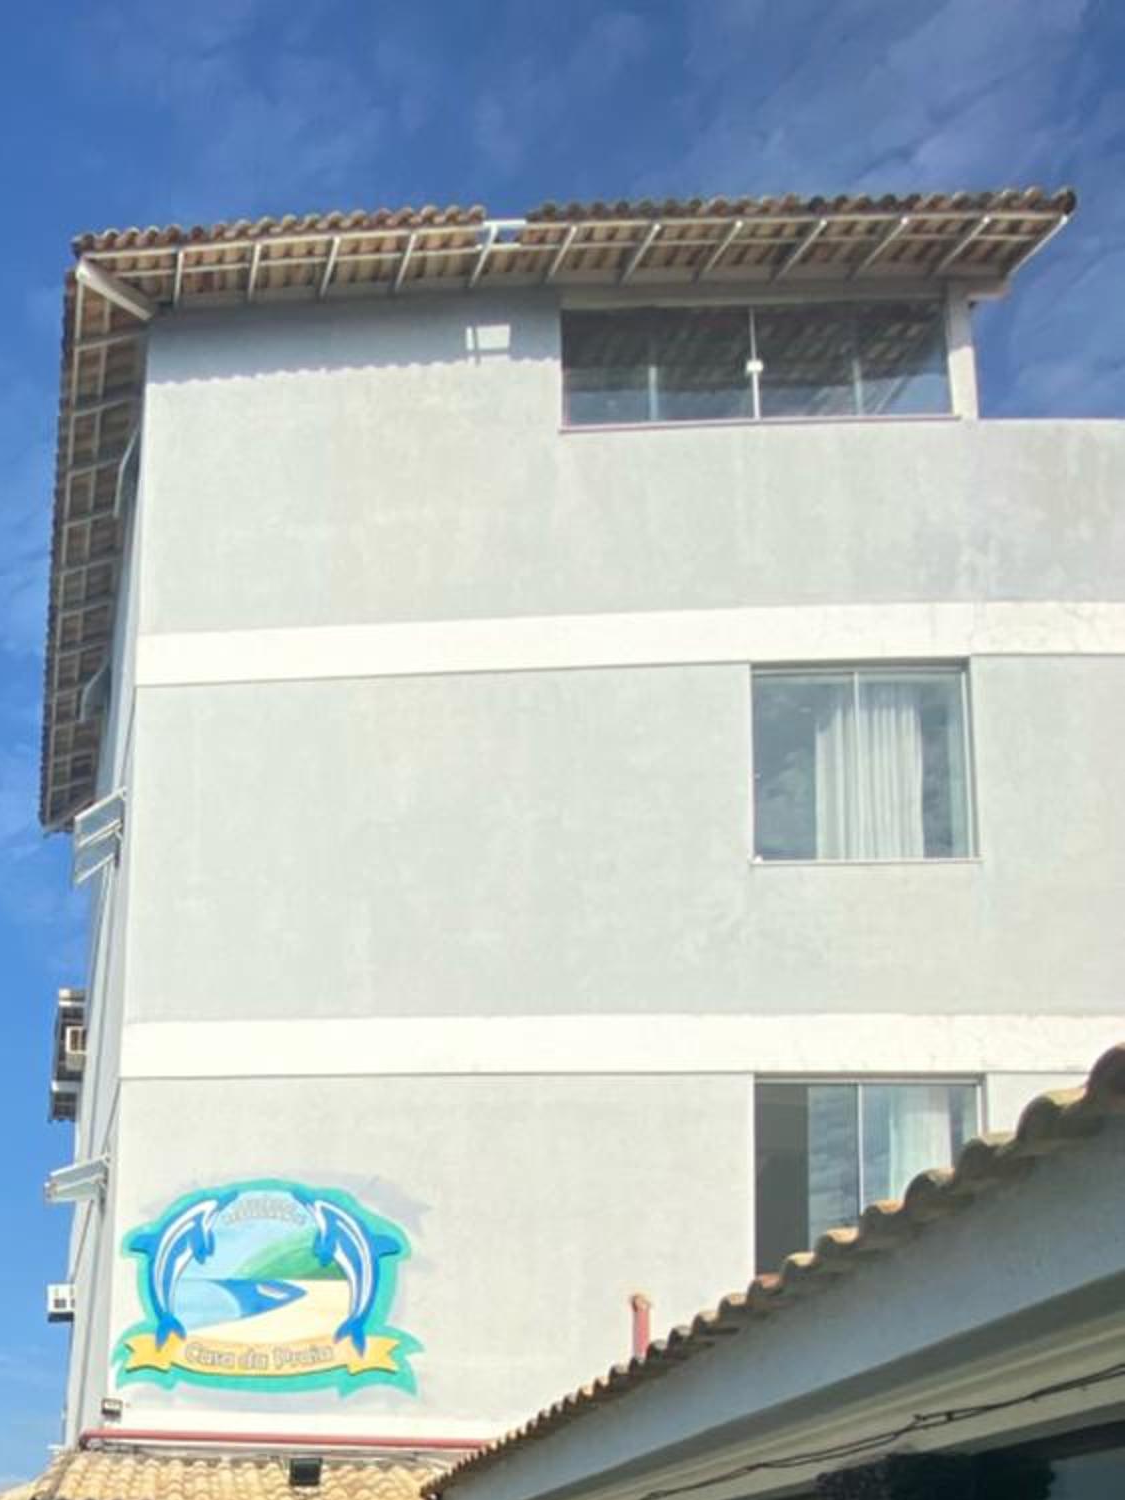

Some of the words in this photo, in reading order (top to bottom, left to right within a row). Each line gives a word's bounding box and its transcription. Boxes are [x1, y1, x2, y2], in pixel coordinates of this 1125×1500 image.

[185, 1342, 235, 1368] Casa
[238, 1347, 269, 1370] da
[272, 1344, 335, 1370] Praia
